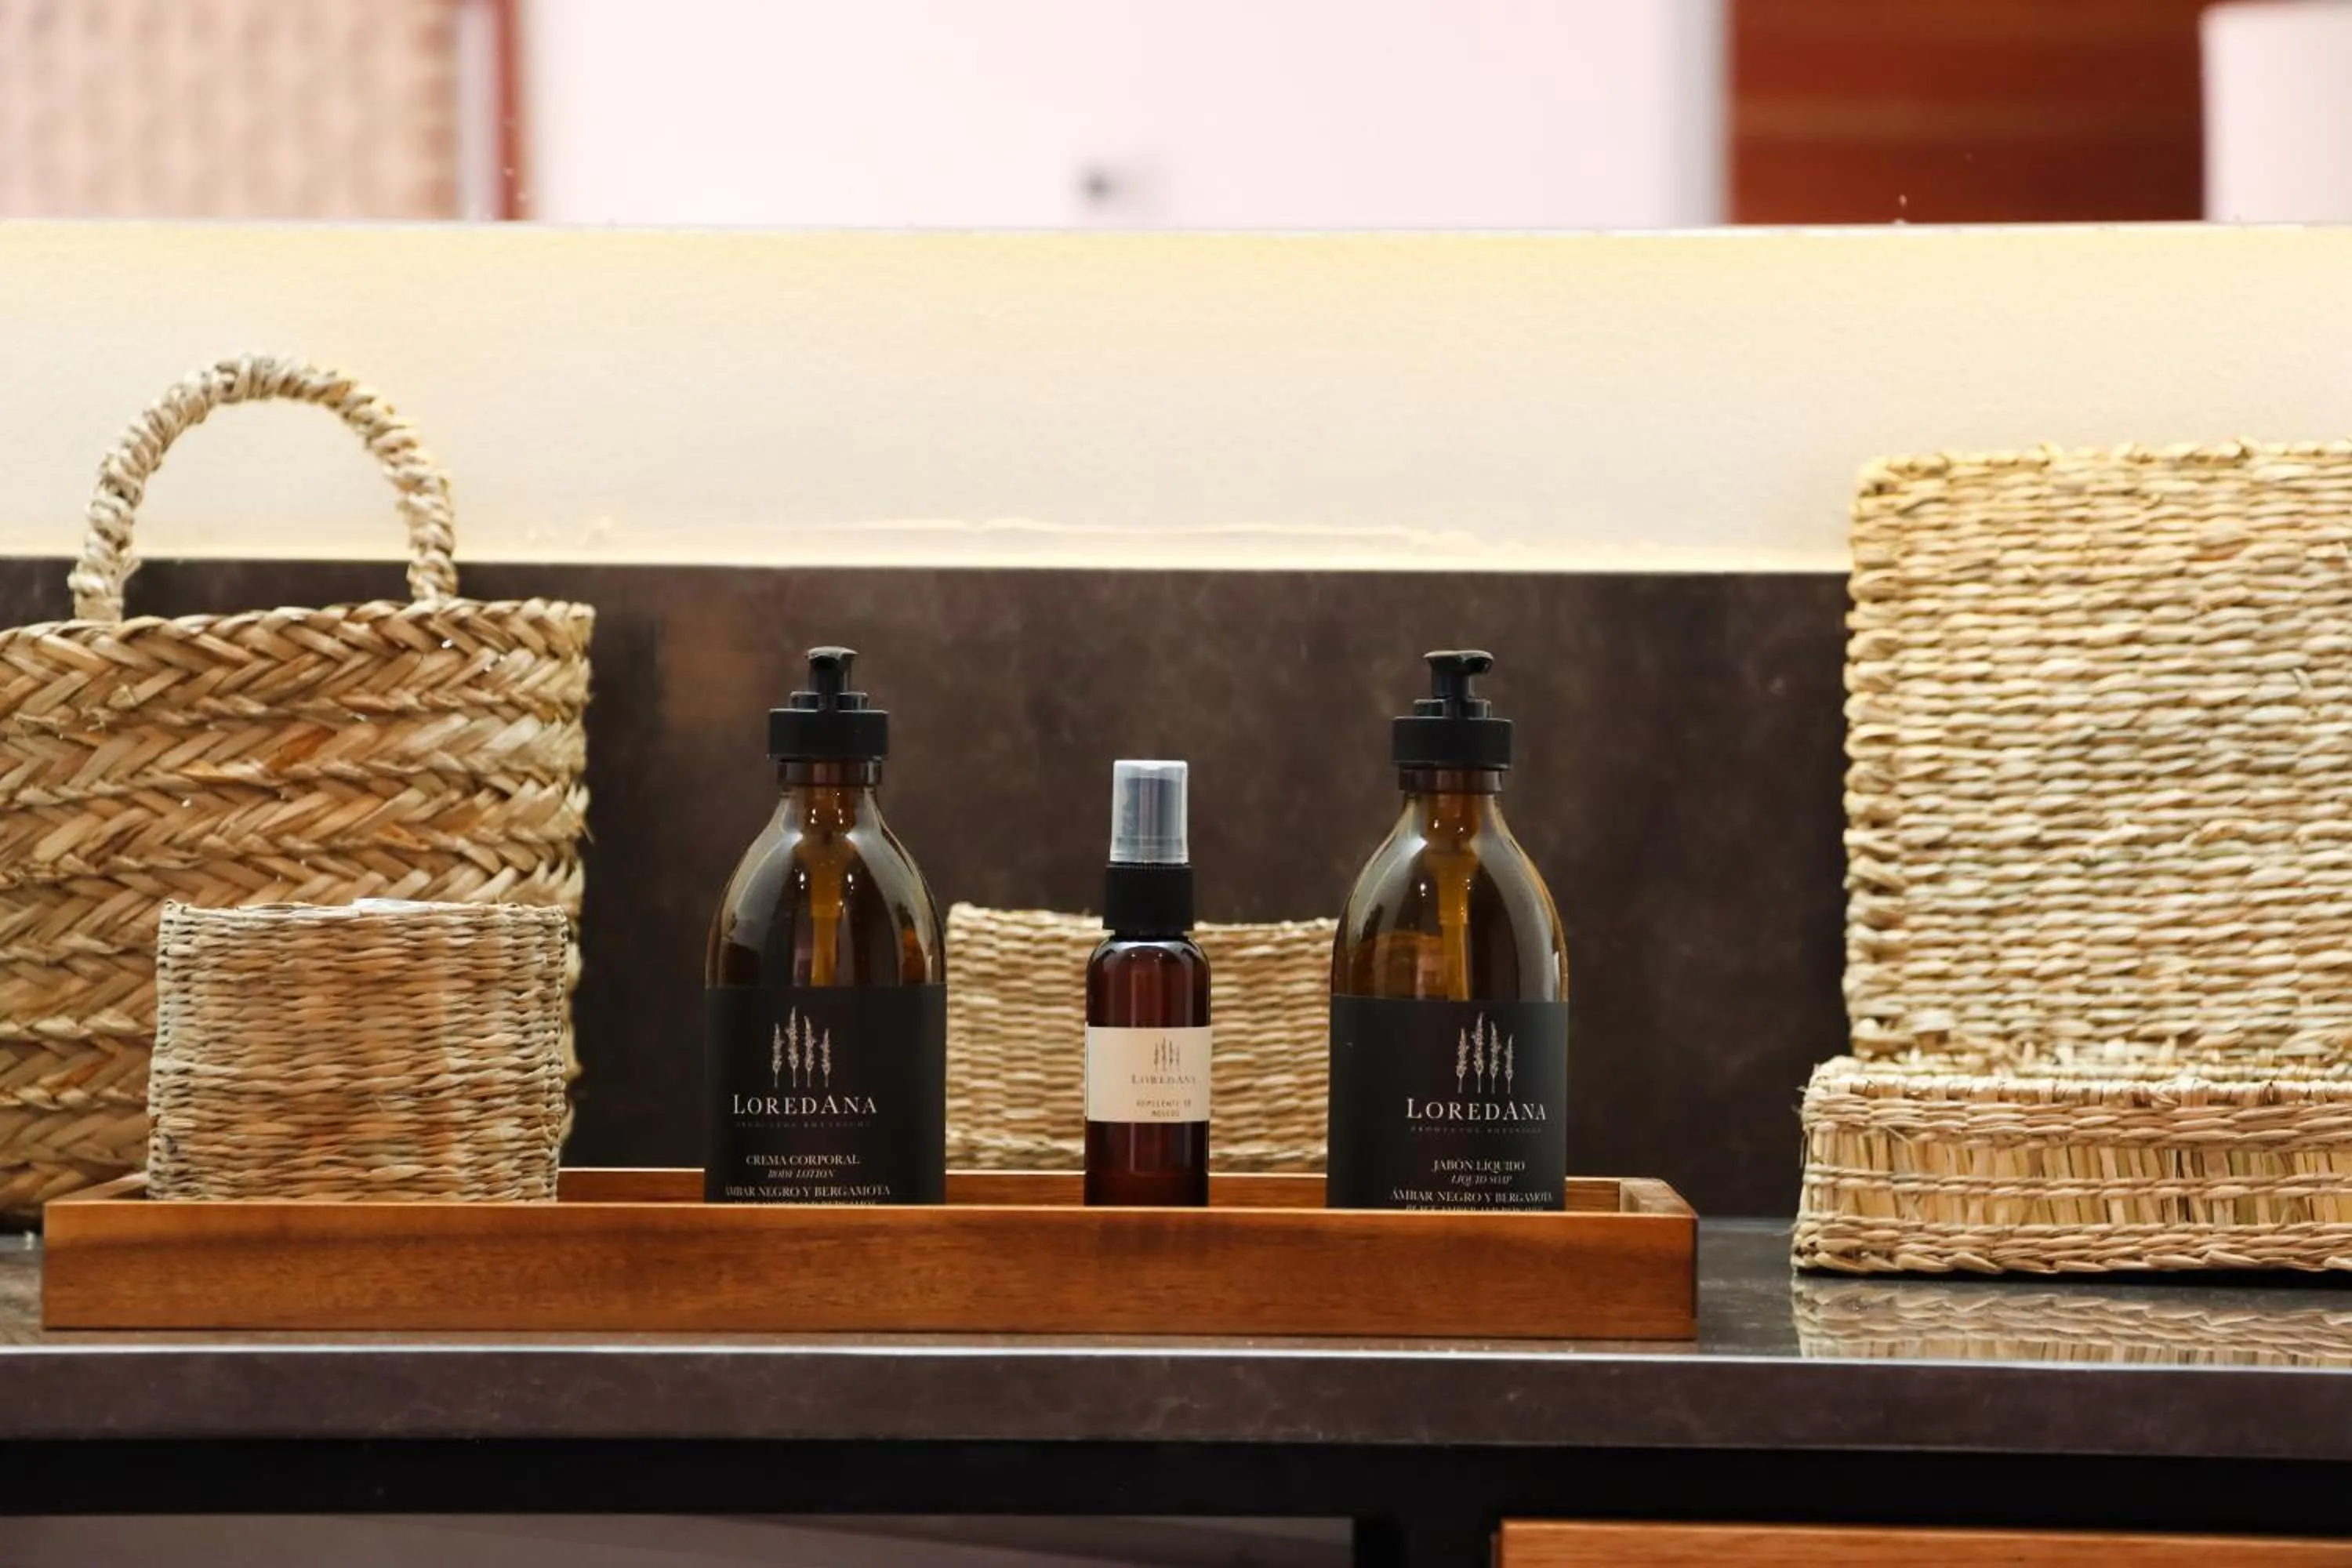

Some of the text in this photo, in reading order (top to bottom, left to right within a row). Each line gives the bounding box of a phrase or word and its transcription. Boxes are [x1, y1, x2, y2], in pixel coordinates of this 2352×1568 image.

[733, 1094, 877, 1115] LOREDANA
[1406, 1098, 1546, 1120] LOREDANA
[746, 1154, 860, 1166] CREMA CORPORAL
[802, 1186, 811, 1197] Y
[1437, 1191, 1482, 1203] NEGRO
[1484, 1192, 1492, 1203] Y
